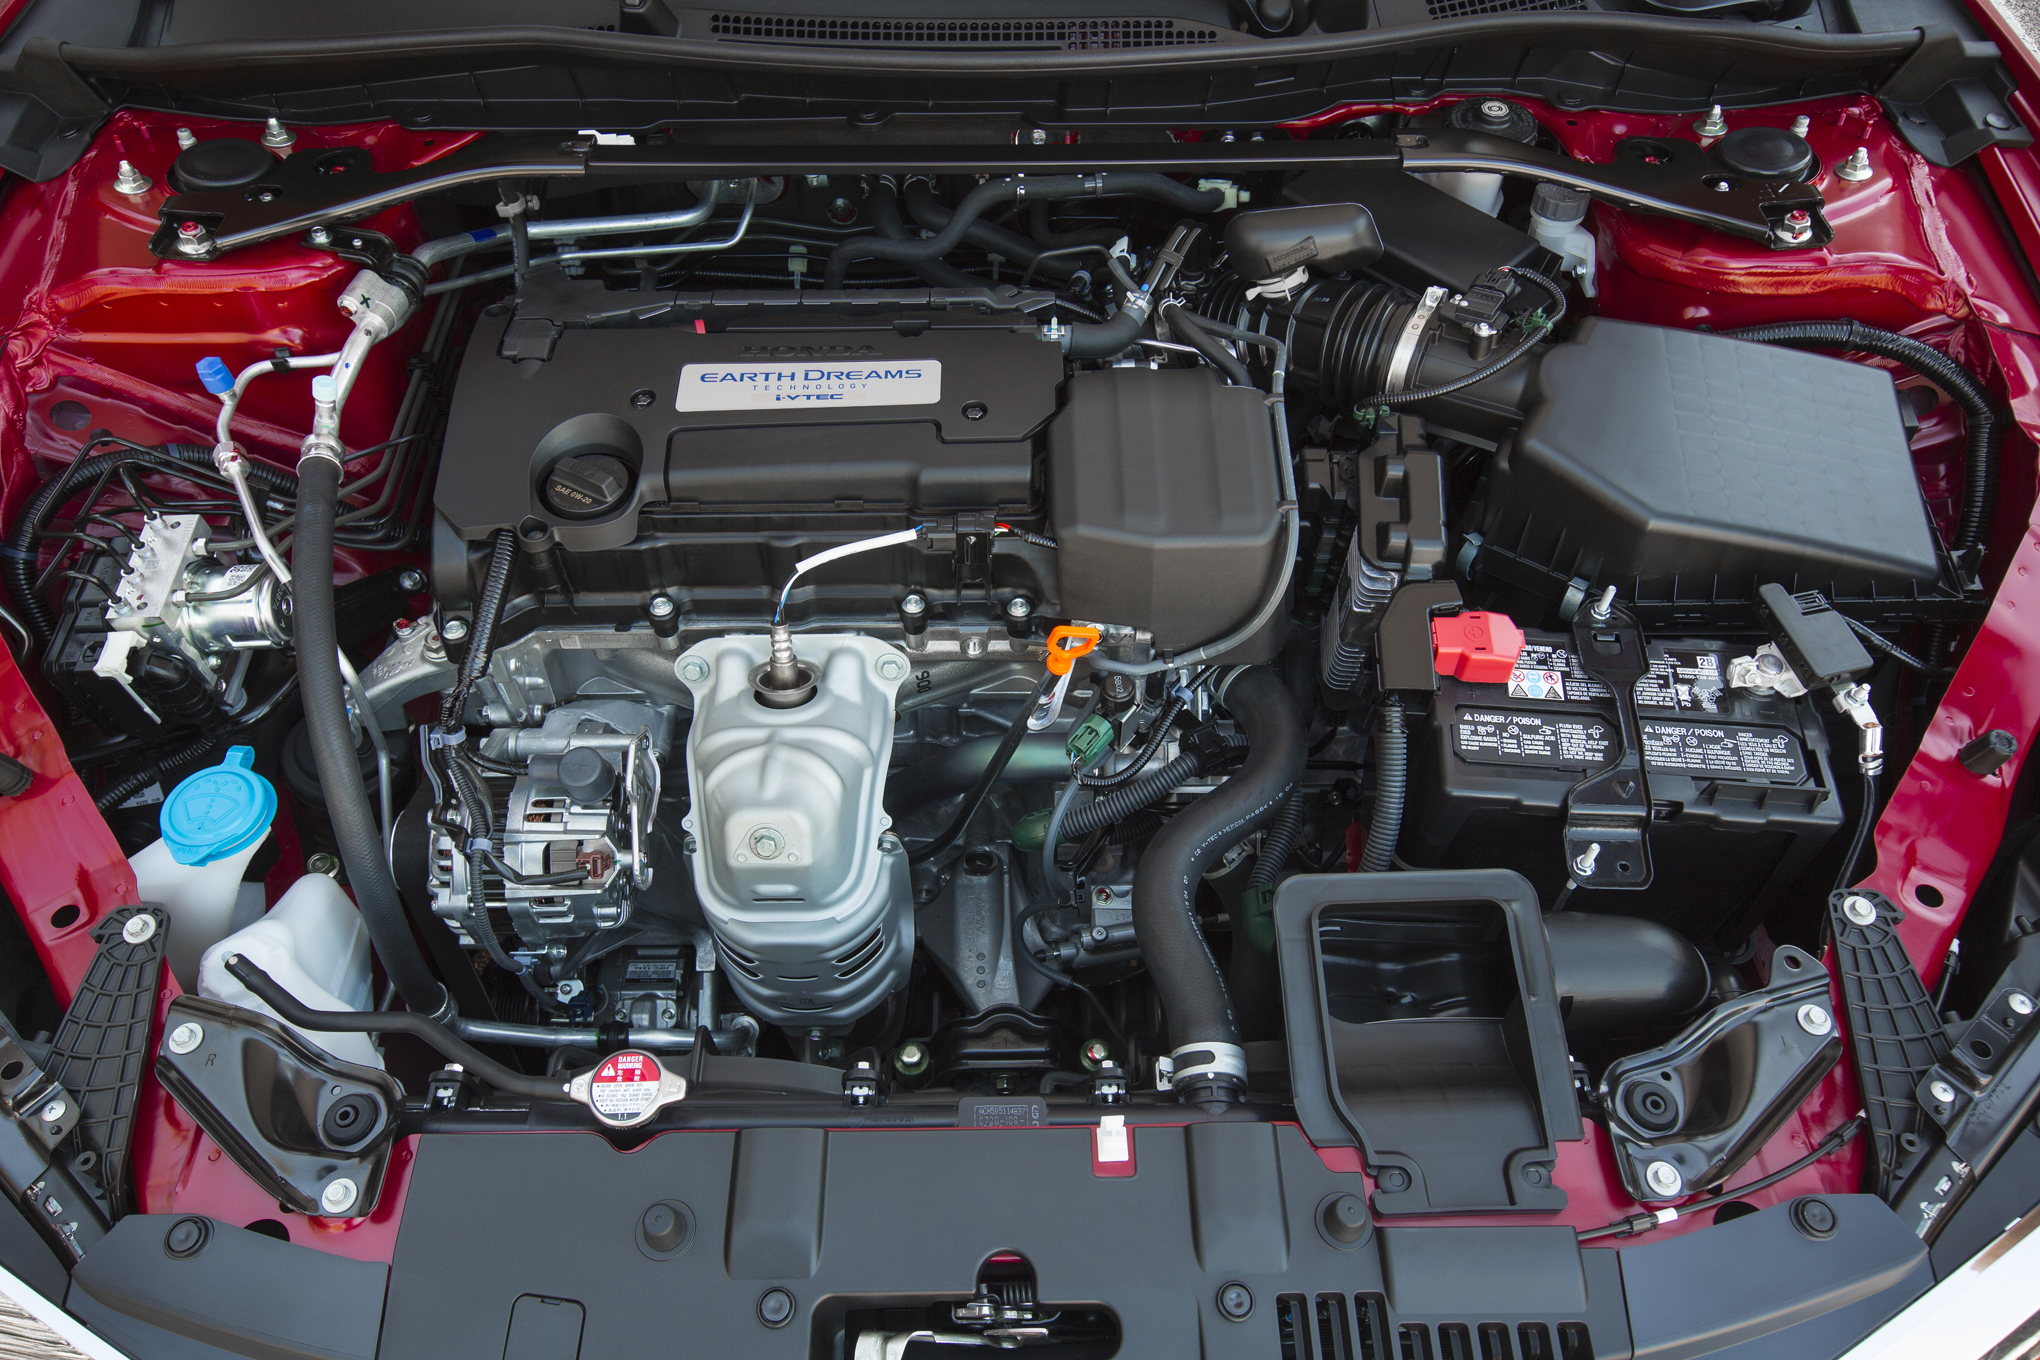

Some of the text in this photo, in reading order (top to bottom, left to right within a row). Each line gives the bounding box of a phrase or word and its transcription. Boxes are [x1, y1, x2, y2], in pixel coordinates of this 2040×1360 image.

[740, 345, 882, 357] HONDA
[700, 369, 922, 382] EARTH DREAMS
[753, 383, 868, 391] TECHNOLOGY
[555, 484, 572, 496] SAE
[1700, 658, 1714, 666] 2B
[1474, 714, 1505, 724] DANGER
[1512, 716, 1542, 726] POISON
[1654, 726, 1687, 735] DANGER
[1694, 728, 1724, 738] POISON
[1202, 834, 1219, 848] Y-TEC
[204, 1053, 217, 1066] R
